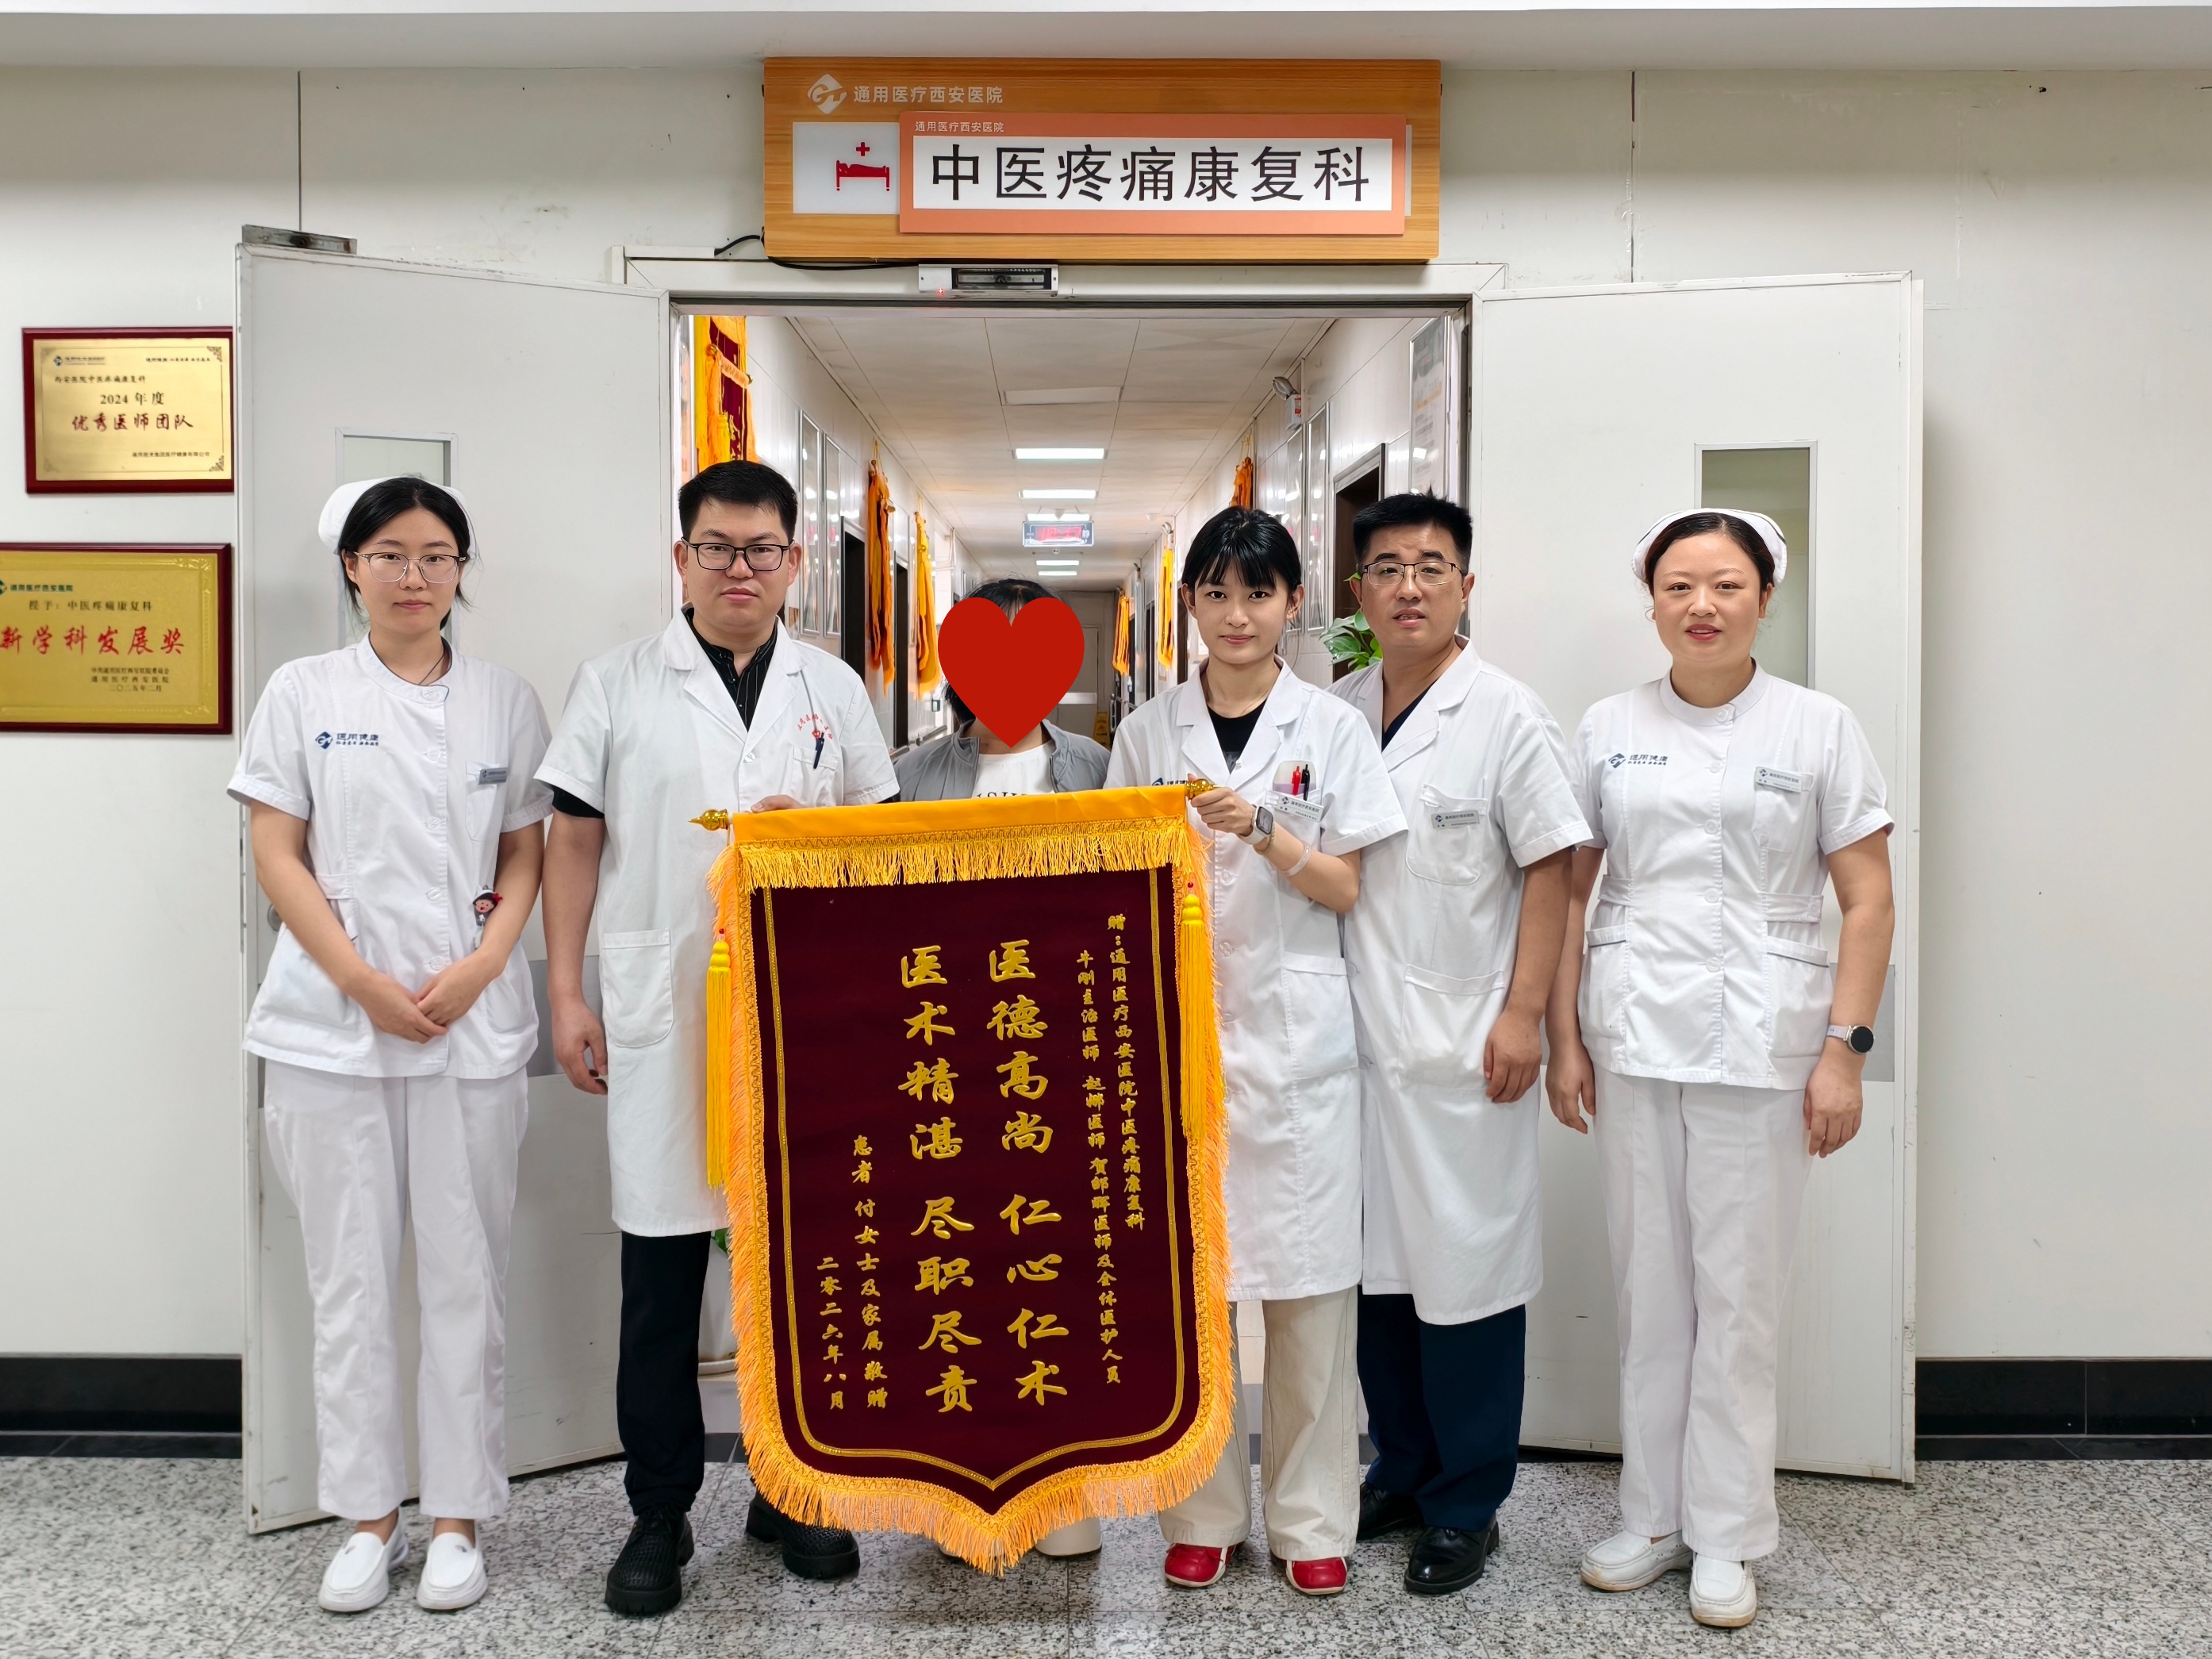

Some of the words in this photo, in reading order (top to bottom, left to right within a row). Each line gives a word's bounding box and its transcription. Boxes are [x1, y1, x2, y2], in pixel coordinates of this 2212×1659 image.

[853, 86, 1003, 103] 通用医疗西安医院
[915, 121, 1004, 132] 通用医疗西安医院
[931, 143, 1370, 203] 中医疼痛康复科
[71, 411, 194, 432] 优秀医师团队
[0, 624, 185, 655] 新学科发展奖
[898, 945, 963, 1160] 医术精湛
[987, 939, 1054, 1154] 医德高尚
[816, 1257, 847, 1410] 二零二六年八月
[911, 1196, 982, 1413] 尽职尽责
[1000, 1193, 1070, 1406] 仁心仁术
